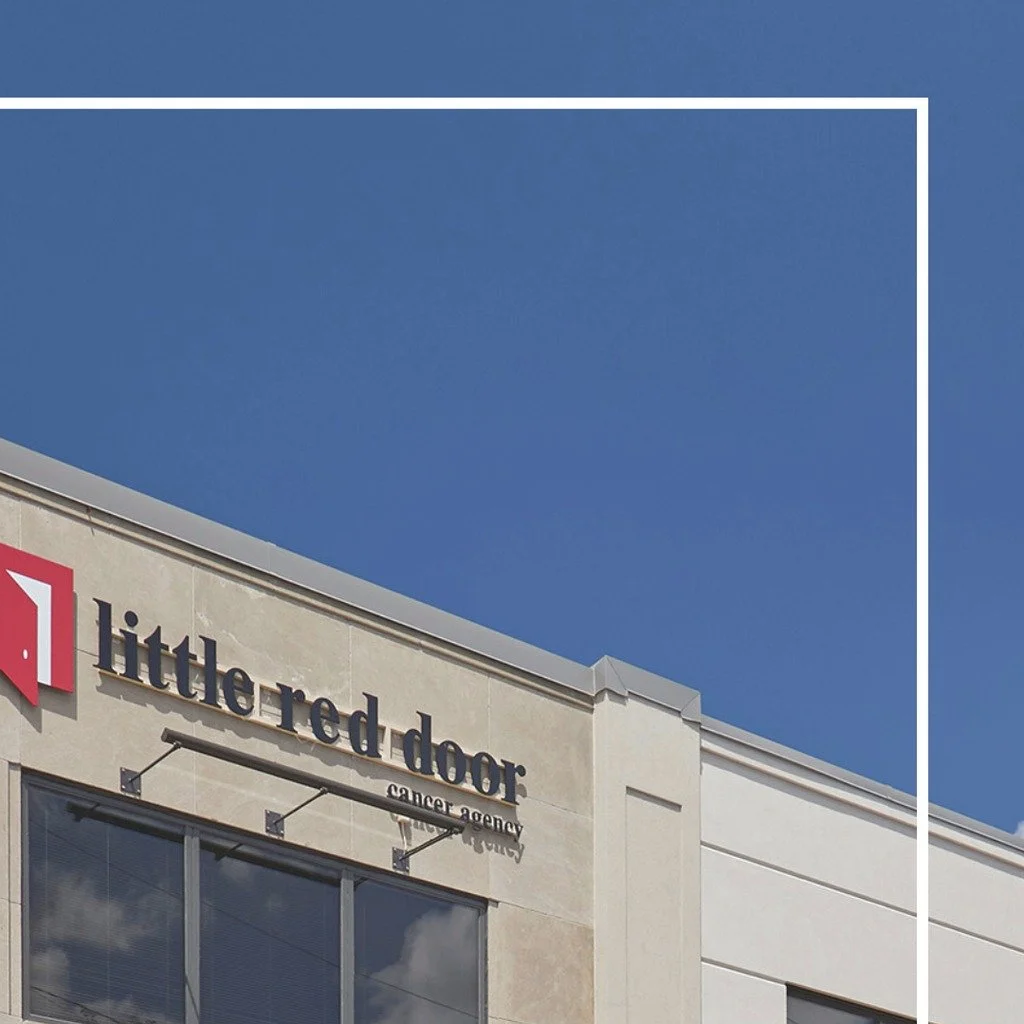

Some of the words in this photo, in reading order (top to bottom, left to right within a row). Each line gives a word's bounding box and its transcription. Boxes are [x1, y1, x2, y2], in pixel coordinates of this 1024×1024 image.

[92, 597, 255, 717] little
[276, 682, 382, 759] red
[402, 711, 527, 806] door
[387, 783, 453, 815] cancer
[461, 807, 524, 842] agency
